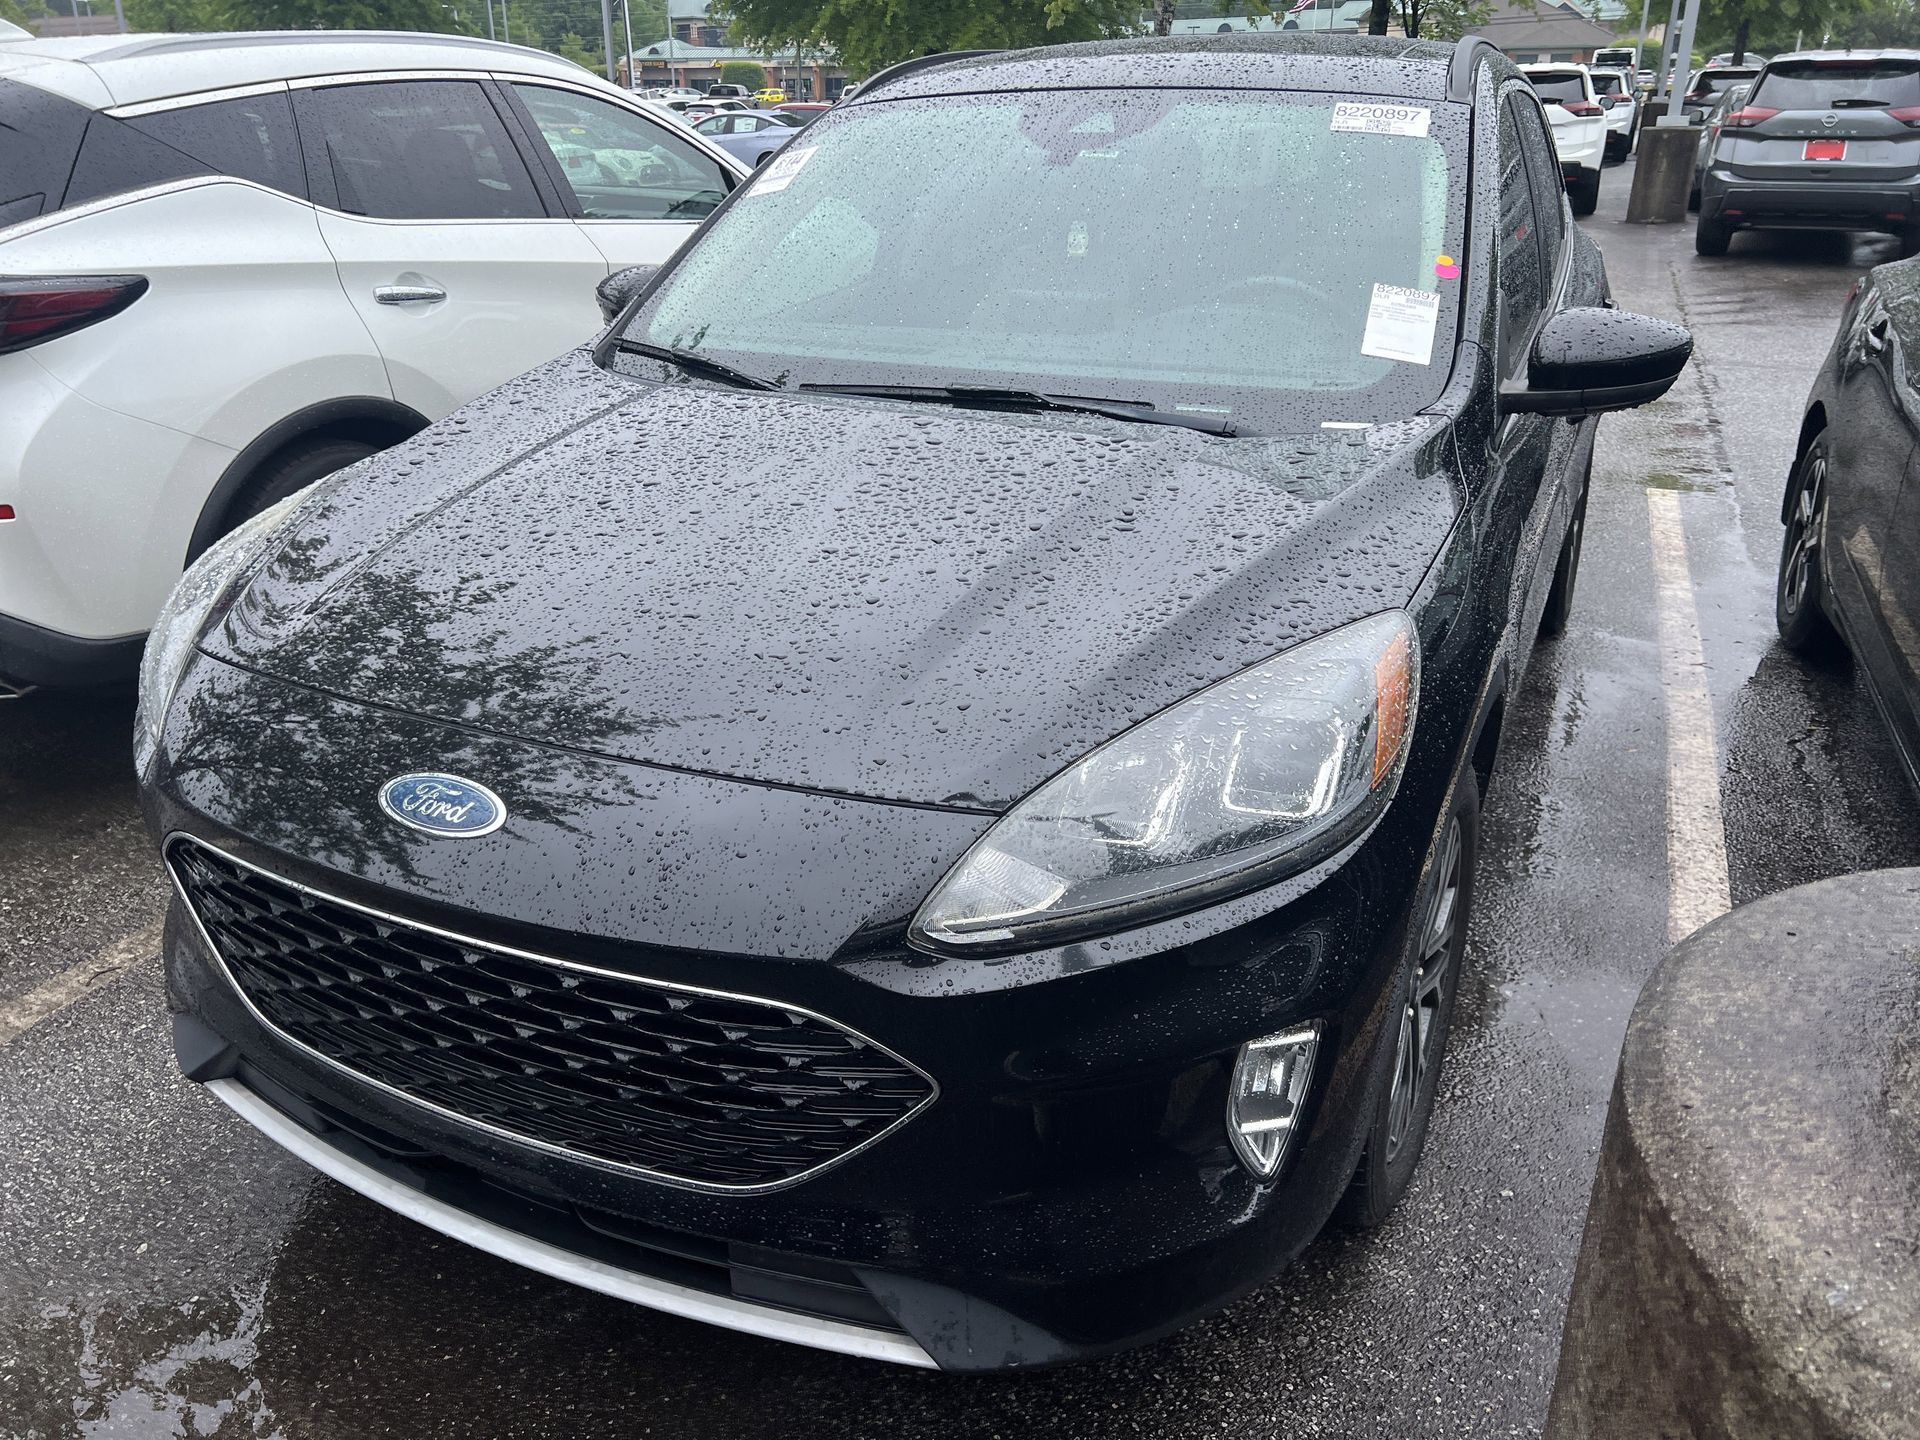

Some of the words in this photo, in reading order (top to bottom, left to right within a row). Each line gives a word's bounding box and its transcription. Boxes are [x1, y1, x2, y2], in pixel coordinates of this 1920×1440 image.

[1336, 106, 1421, 121] 8220897
[1377, 284, 1439, 301] 8220897
[402, 783, 475, 823] Ford
